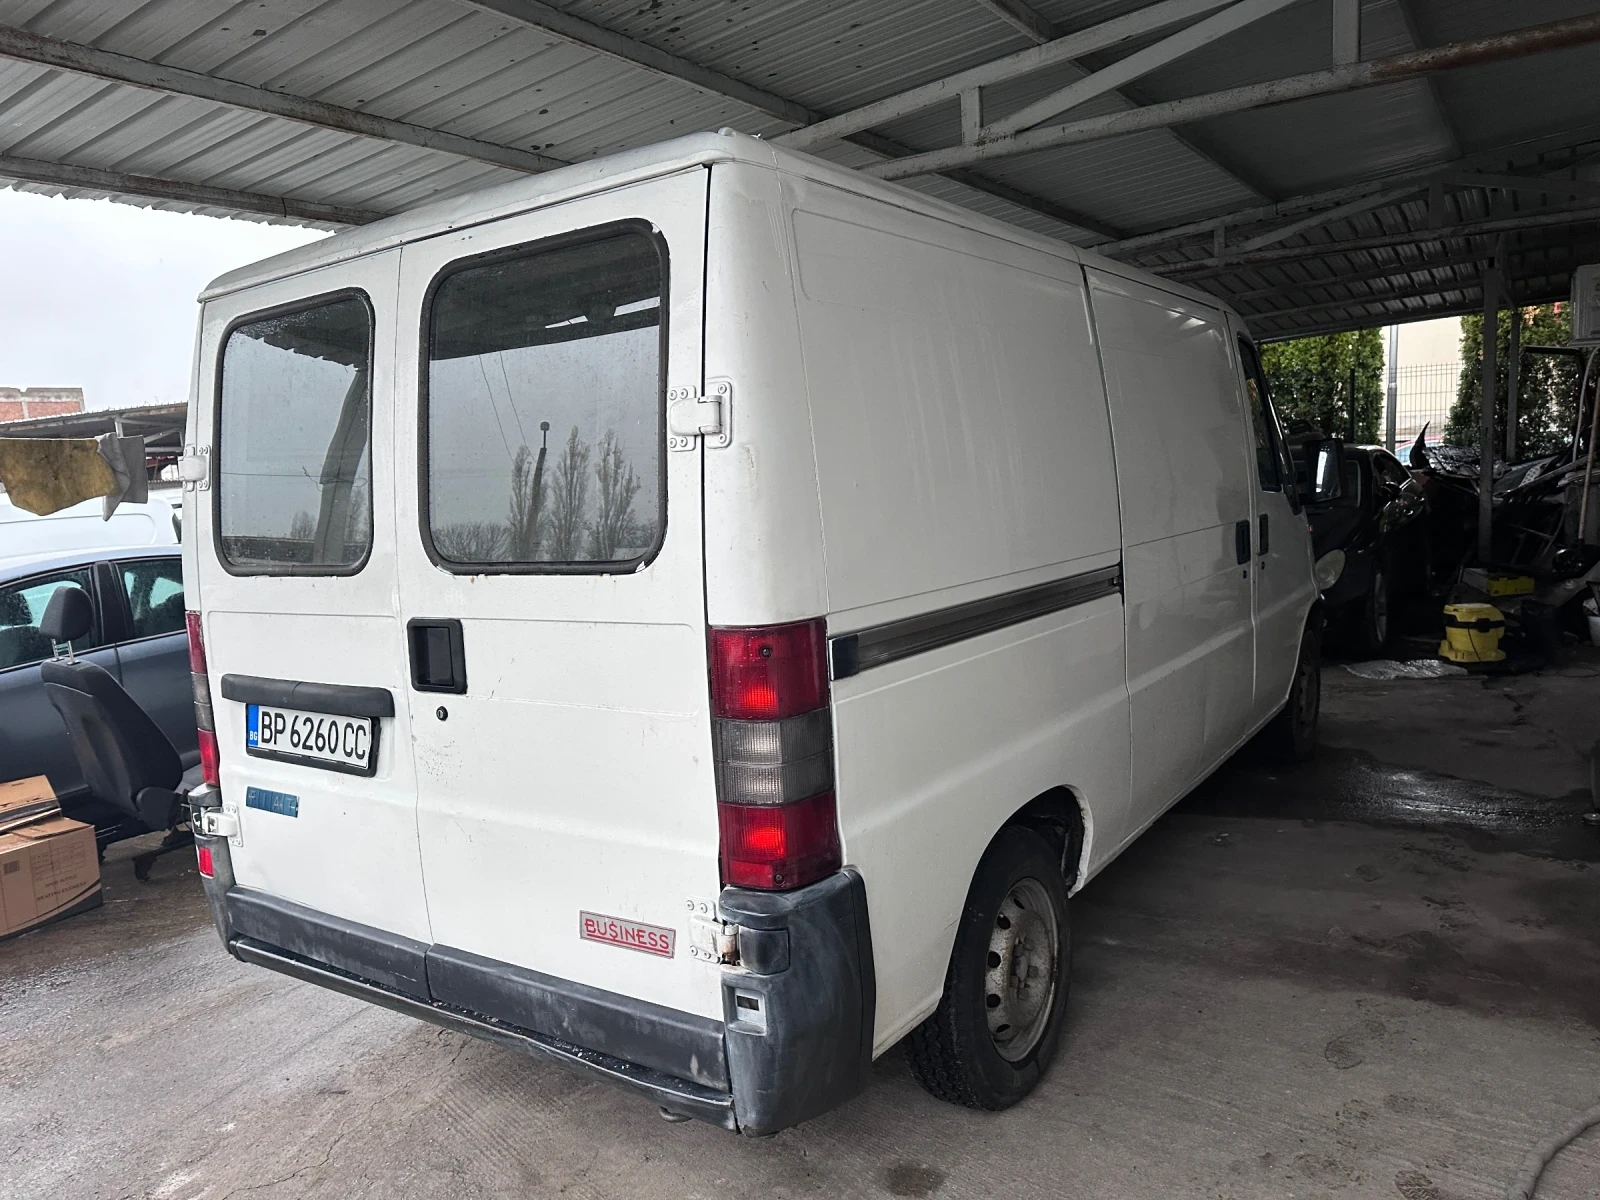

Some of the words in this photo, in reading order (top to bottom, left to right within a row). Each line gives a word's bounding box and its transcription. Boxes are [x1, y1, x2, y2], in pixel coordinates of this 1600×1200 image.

[249, 730, 258, 741] BG
[261, 711, 286, 745] BP
[290, 715, 339, 755] 6260
[343, 722, 367, 760] CC
[247, 789, 296, 814] FIAT
